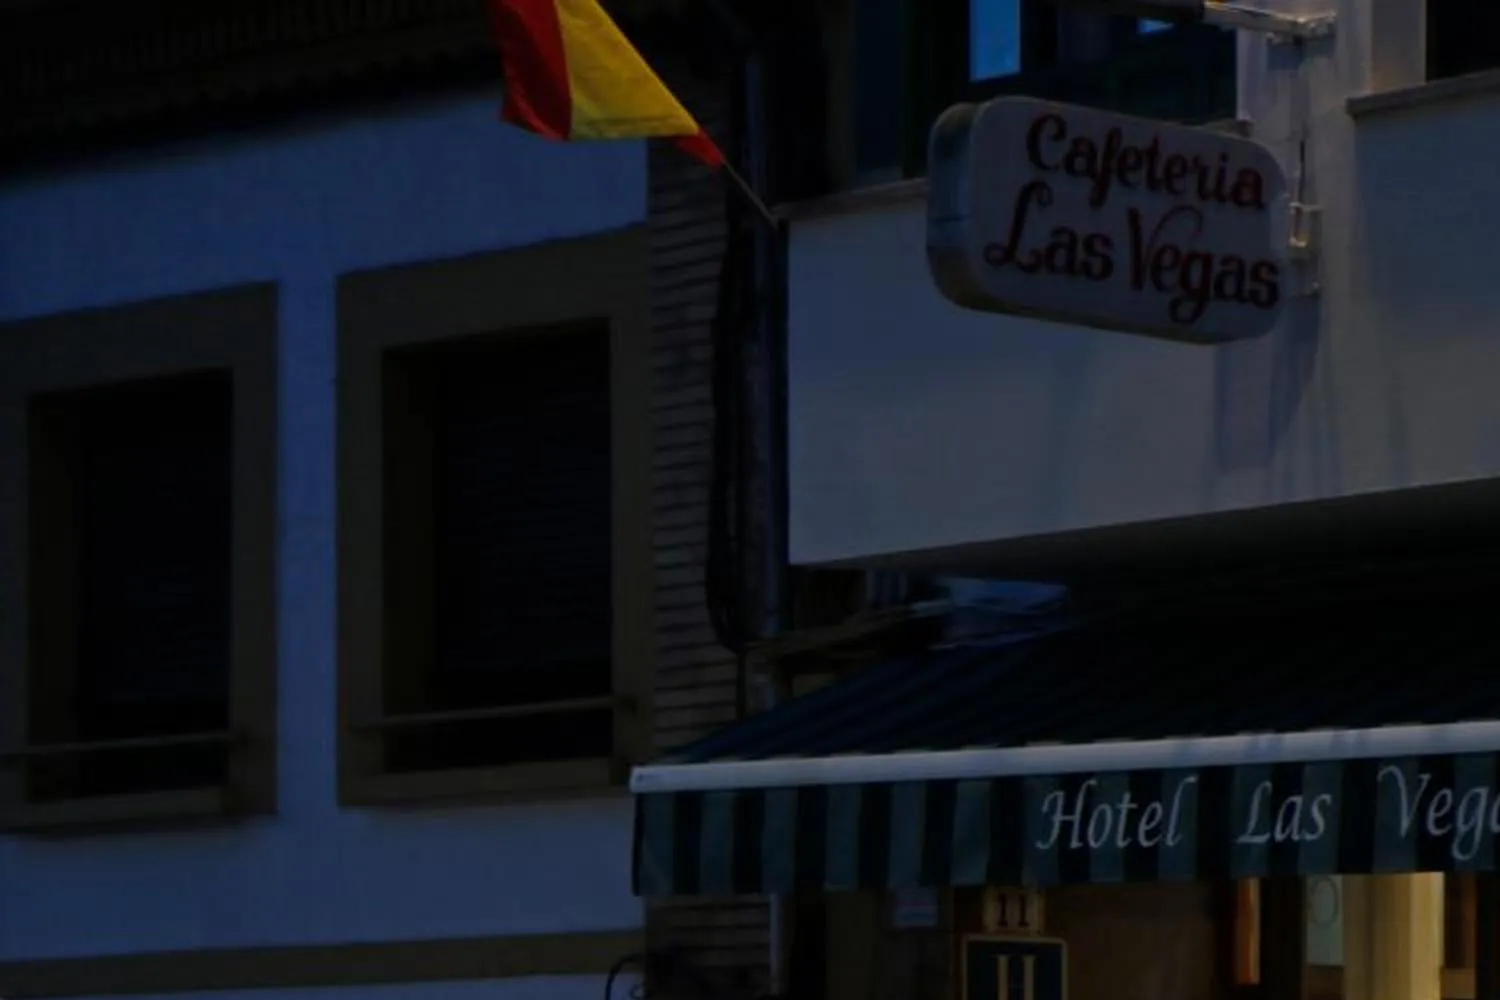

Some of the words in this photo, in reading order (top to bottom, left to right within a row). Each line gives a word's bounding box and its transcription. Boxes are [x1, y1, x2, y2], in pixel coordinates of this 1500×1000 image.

[983, 181, 1113, 280] Las
[1128, 205, 1280, 324] Vegas
[1035, 776, 1197, 851] Hotel
[1232, 780, 1332, 845] Las
